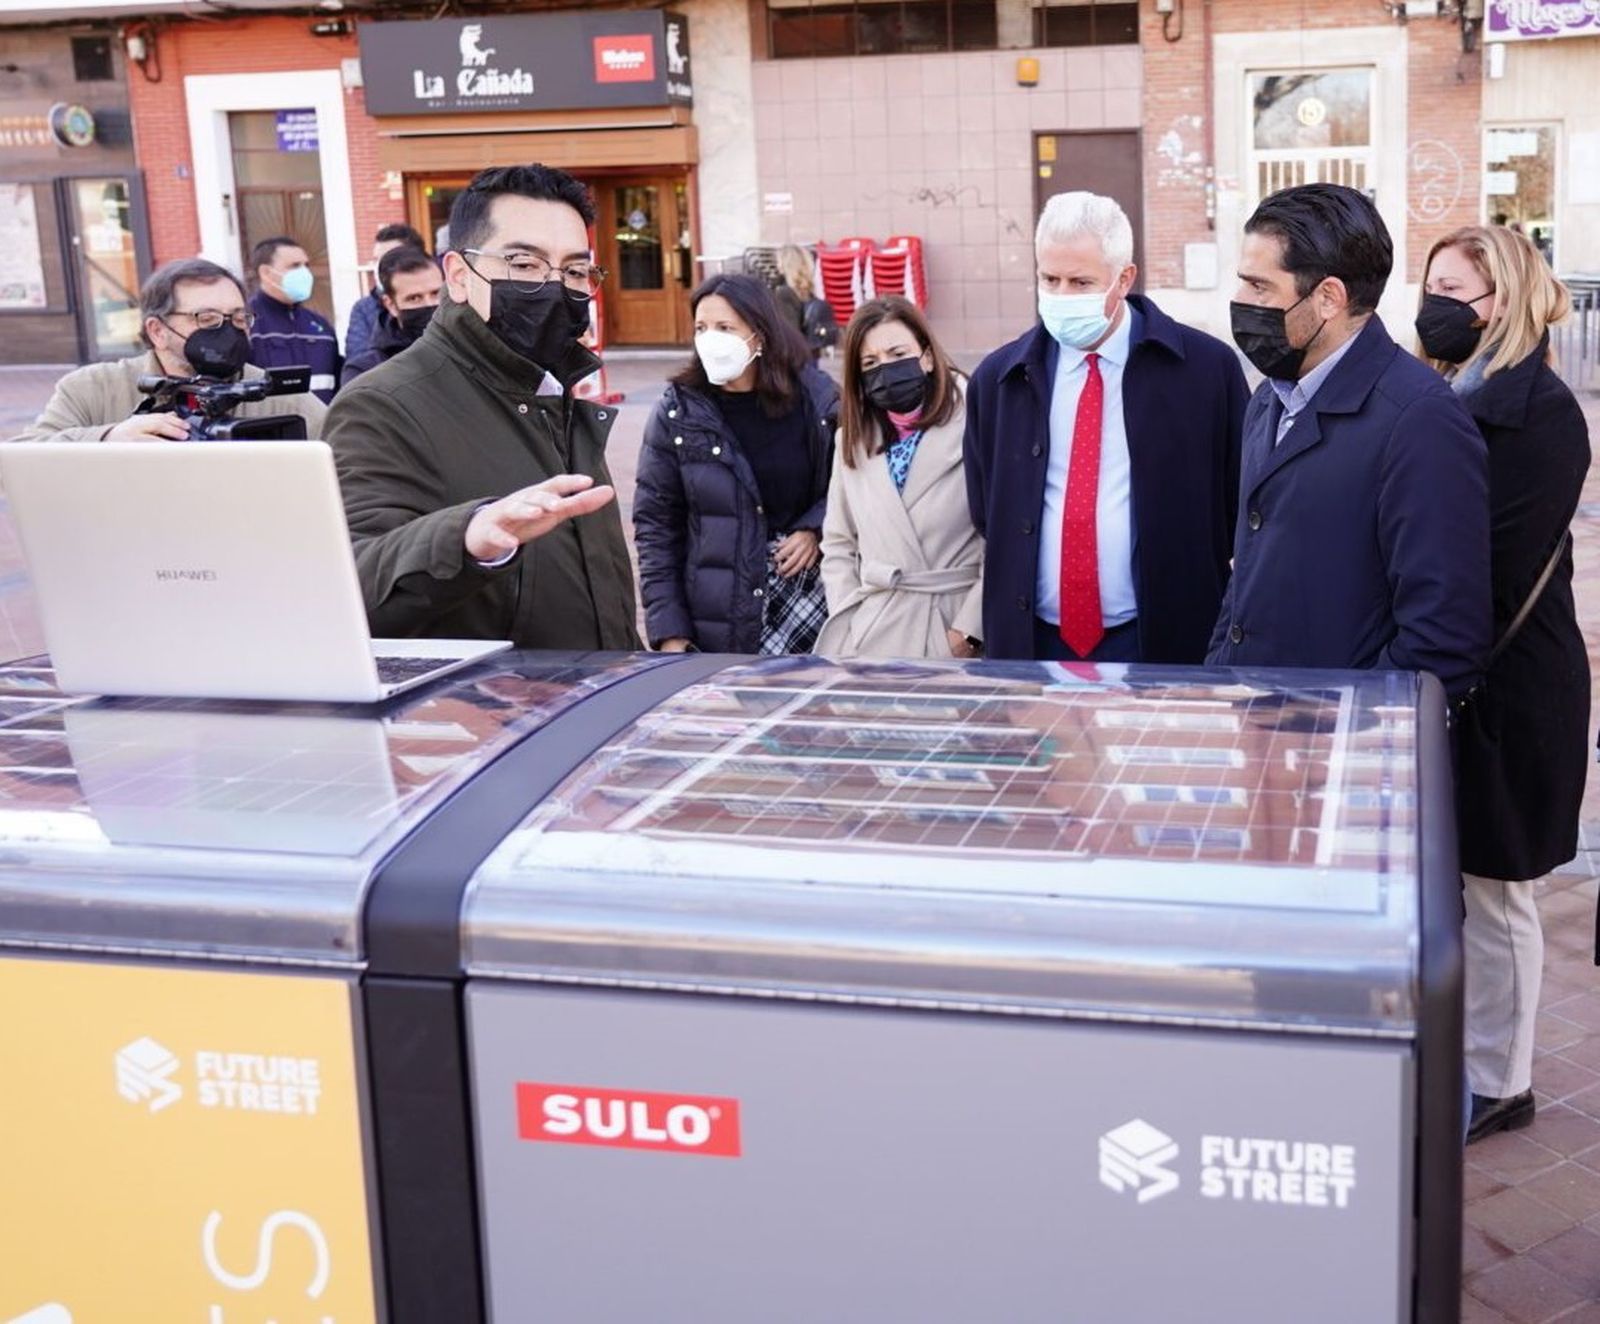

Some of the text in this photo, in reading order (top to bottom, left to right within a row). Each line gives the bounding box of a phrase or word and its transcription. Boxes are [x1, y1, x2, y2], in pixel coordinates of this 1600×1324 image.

[413, 67, 535, 99] La Cañada
[155, 569, 218, 582] HUAWEI
[196, 1050, 319, 1086] FUTURE
[198, 1078, 322, 1116] STREET
[542, 1093, 712, 1147] SULO
[1201, 1134, 1356, 1177] FUTURE
[1200, 1165, 1356, 1208] STREET
